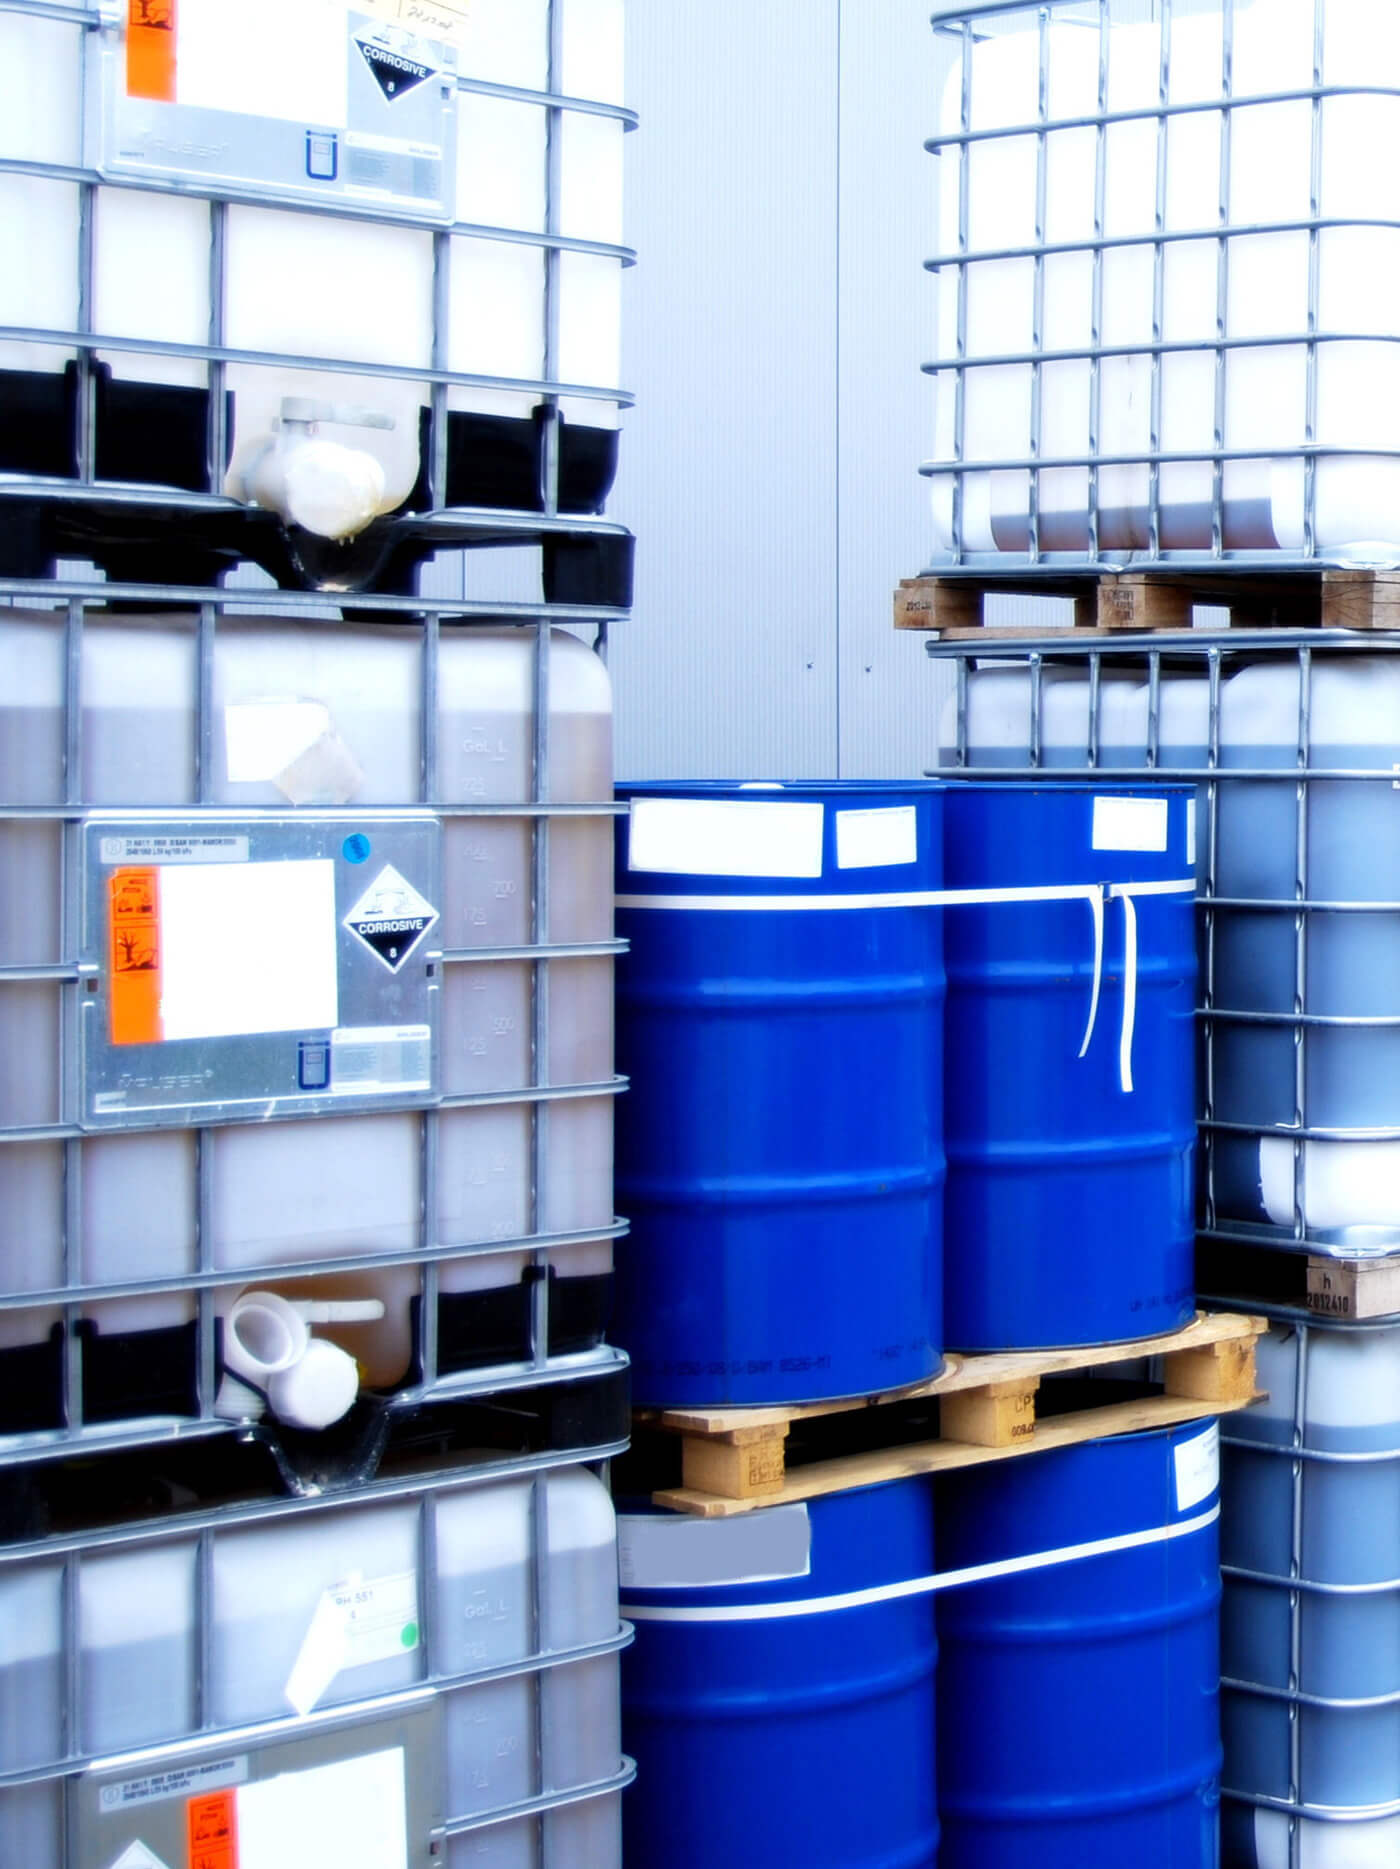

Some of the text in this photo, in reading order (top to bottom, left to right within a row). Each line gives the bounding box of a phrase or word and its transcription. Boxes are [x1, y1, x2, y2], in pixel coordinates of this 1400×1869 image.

[363, 45, 427, 79] CORROSIVE
[387, 82, 395, 92] 8
[357, 919, 424, 936] CORROSIVE
[388, 946, 398, 959] 8
